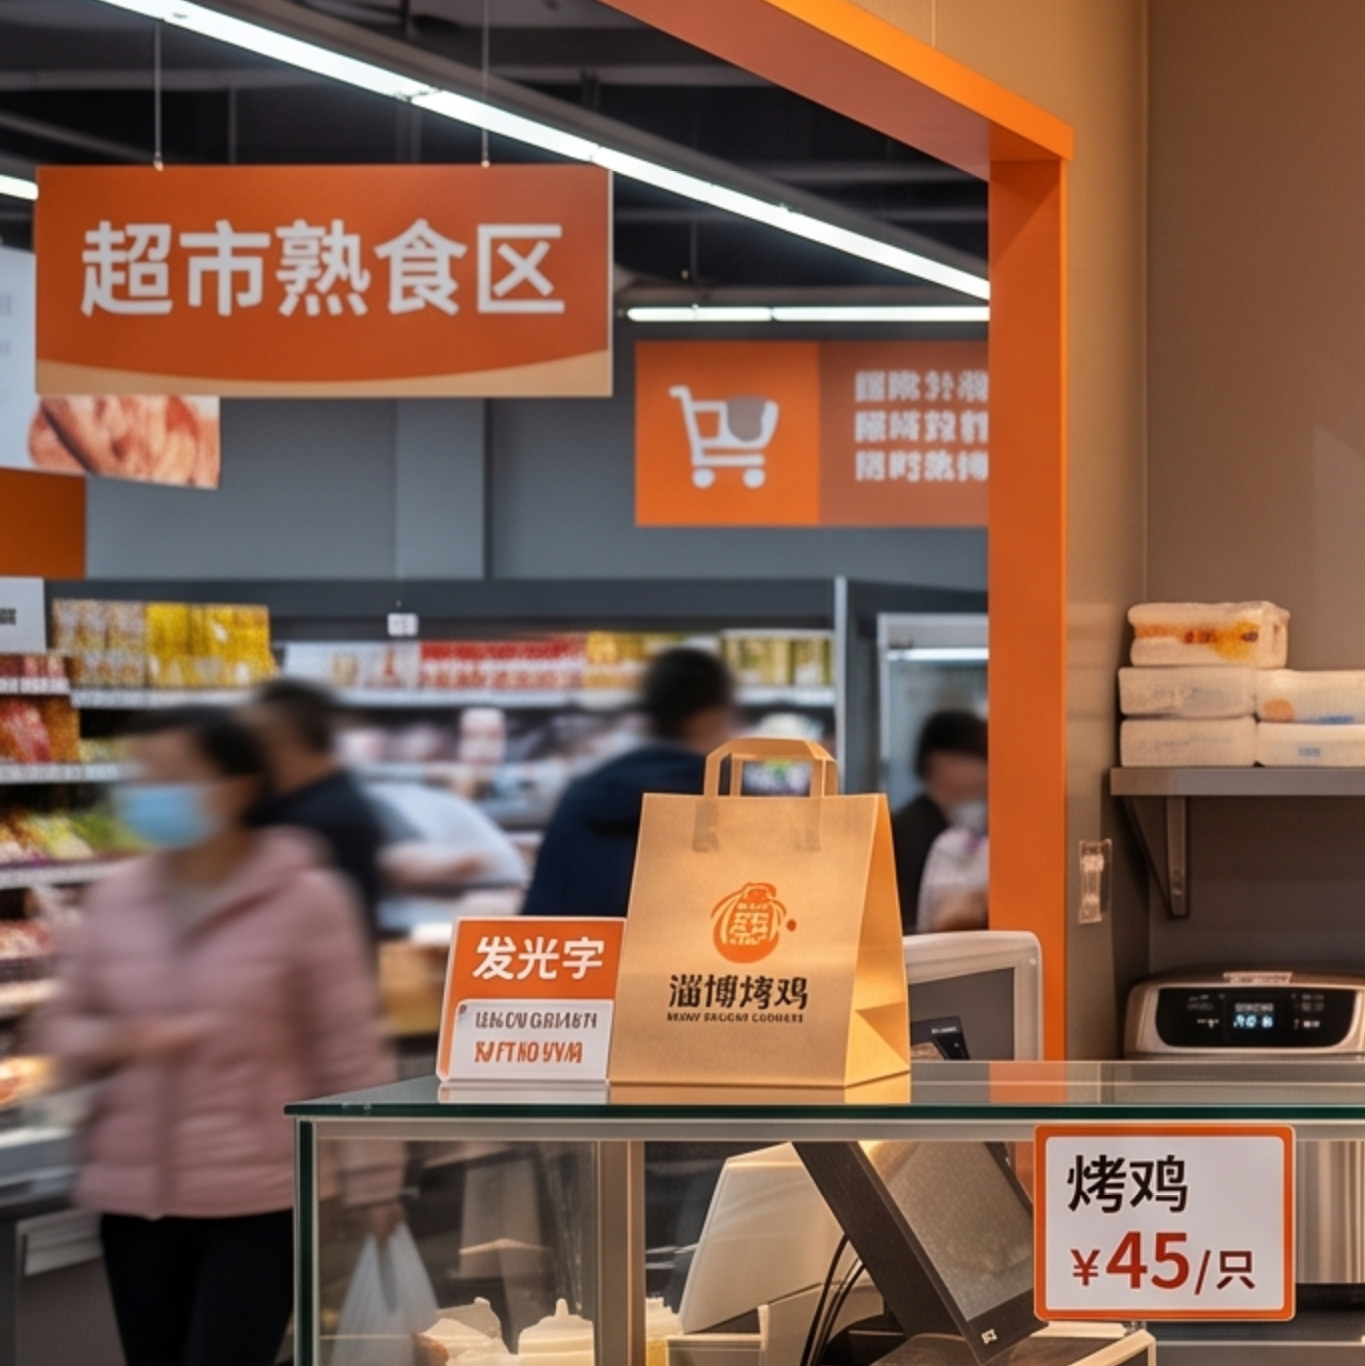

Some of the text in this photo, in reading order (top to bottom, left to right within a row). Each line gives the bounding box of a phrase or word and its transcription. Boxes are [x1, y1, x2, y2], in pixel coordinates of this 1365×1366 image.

[80, 218, 566, 319] 超市熟食区
[472, 936, 605, 981] 发光字
[1066, 1154, 1188, 1213] 烤鸡
